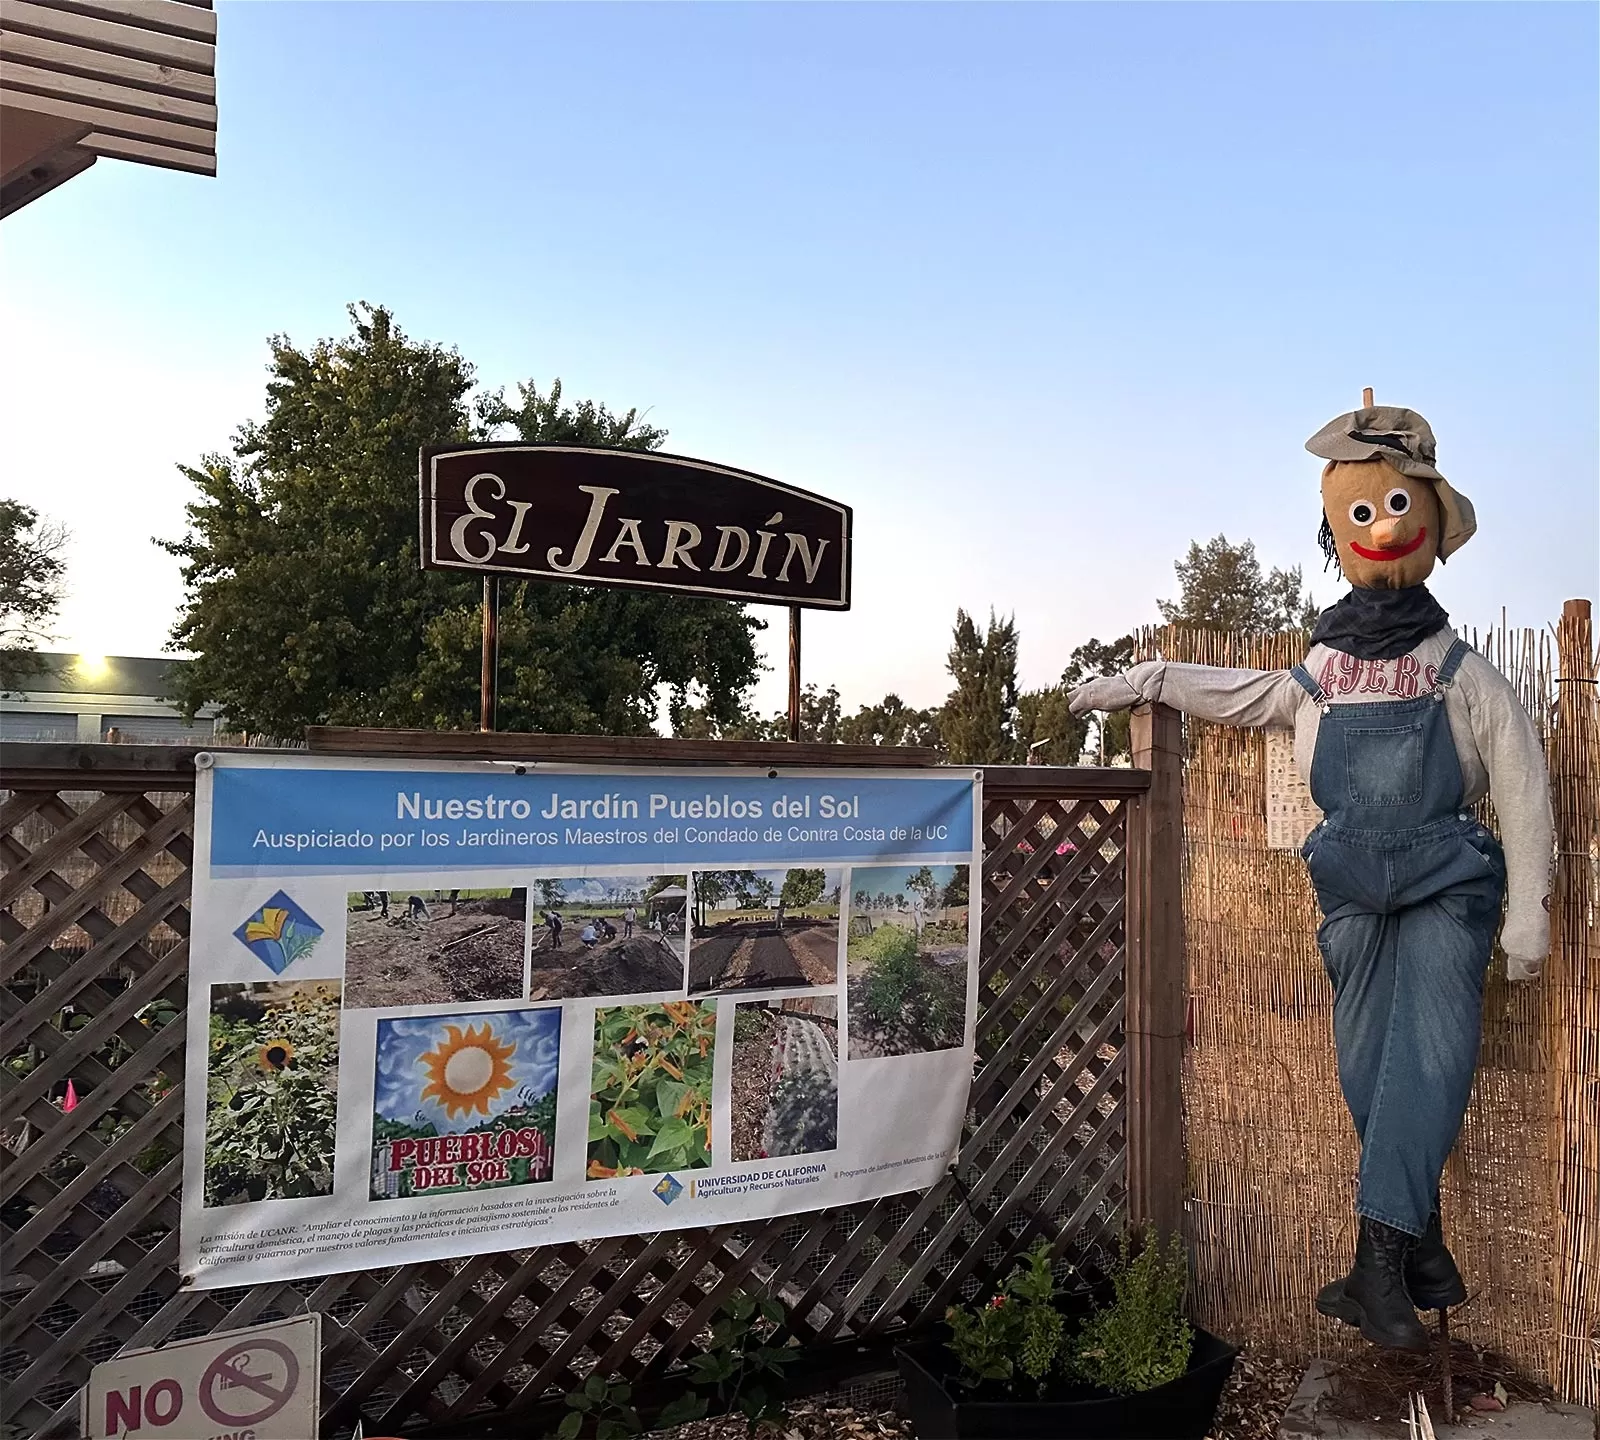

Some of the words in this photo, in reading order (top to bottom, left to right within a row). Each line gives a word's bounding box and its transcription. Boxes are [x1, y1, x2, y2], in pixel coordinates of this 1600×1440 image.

[397, 792, 531, 819] Nuestro
[541, 793, 638, 819] Jardín
[649, 794, 763, 819] Pueblos
[772, 795, 810, 818] del
[819, 795, 859, 818] Sol
[252, 829, 374, 851] Auspiciado
[380, 832, 415, 851] por
[421, 829, 450, 847] los
[456, 829, 558, 846] Jardineros
[565, 828, 648, 845] Maestros
[653, 827, 679, 843] del
[684, 826, 758, 843] Condado
[763, 826, 782, 842] de
[787, 826, 838, 842] Contra
[843, 825, 885, 841] Costa
[889, 826, 907, 840] de
[910, 826, 922, 840] la
[926, 825, 948, 840] UC
[388, 1127, 537, 1172] PUEBLOS
[412, 1166, 461, 1191] DEL
[467, 1161, 511, 1186] SOL
[697, 1173, 760, 1188] UNIVERSIDAD
[762, 1171, 773, 1180] DE
[775, 1164, 827, 1179] CALIFORNIA
[697, 1185, 741, 1199] Agricultura
[743, 1185, 749, 1194] y
[749, 1180, 783, 1191] Recursos
[784, 1175, 820, 1186] Naturales
[200, 1236, 212, 1244] La
[214, 1231, 245, 1241] misión
[247, 1230, 258, 1239] de
[344, 1219, 352, 1227] el
[353, 1214, 410, 1226] conocimiento
[419, 1211, 427, 1219] la
[429, 1205, 479, 1219] información
[480, 1201, 513, 1211] basados
[525, 1198, 533, 1206] la
[535, 1192, 586, 1204] investigación
[587, 1189, 607, 1199] sobre
[609, 1188, 617, 1196] la
[200, 1242, 255, 1253] horticultura
[256, 1237, 305, 1249] doméstica,
[307, 1234, 315, 1242] el
[317, 1232, 349, 1243] manejo
[351, 1229, 362, 1238] de
[363, 1228, 392, 1238] plagas
[394, 1226, 400, 1234] y
[402, 1224, 413, 1232] las
[415, 1219, 454, 1231] prácticas
[455, 1216, 465, 1225] de
[466, 1212, 510, 1225] paisajismo
[511, 1207, 549, 1218] sostenible
[558, 1204, 568, 1212] los
[570, 1200, 609, 1211] residentes
[610, 1198, 619, 1206] de
[199, 1254, 245, 1266] California
[247, 1254, 253, 1262] y
[255, 1249, 297, 1261] guiarnos
[297, 1247, 314, 1257] por
[316, 1242, 353, 1253] nuestros
[354, 1239, 387, 1248] valores
[386, 1230, 450, 1246] fundamentales
[458, 1223, 499, 1235] iniciativas
[105, 1378, 183, 1437] NO
